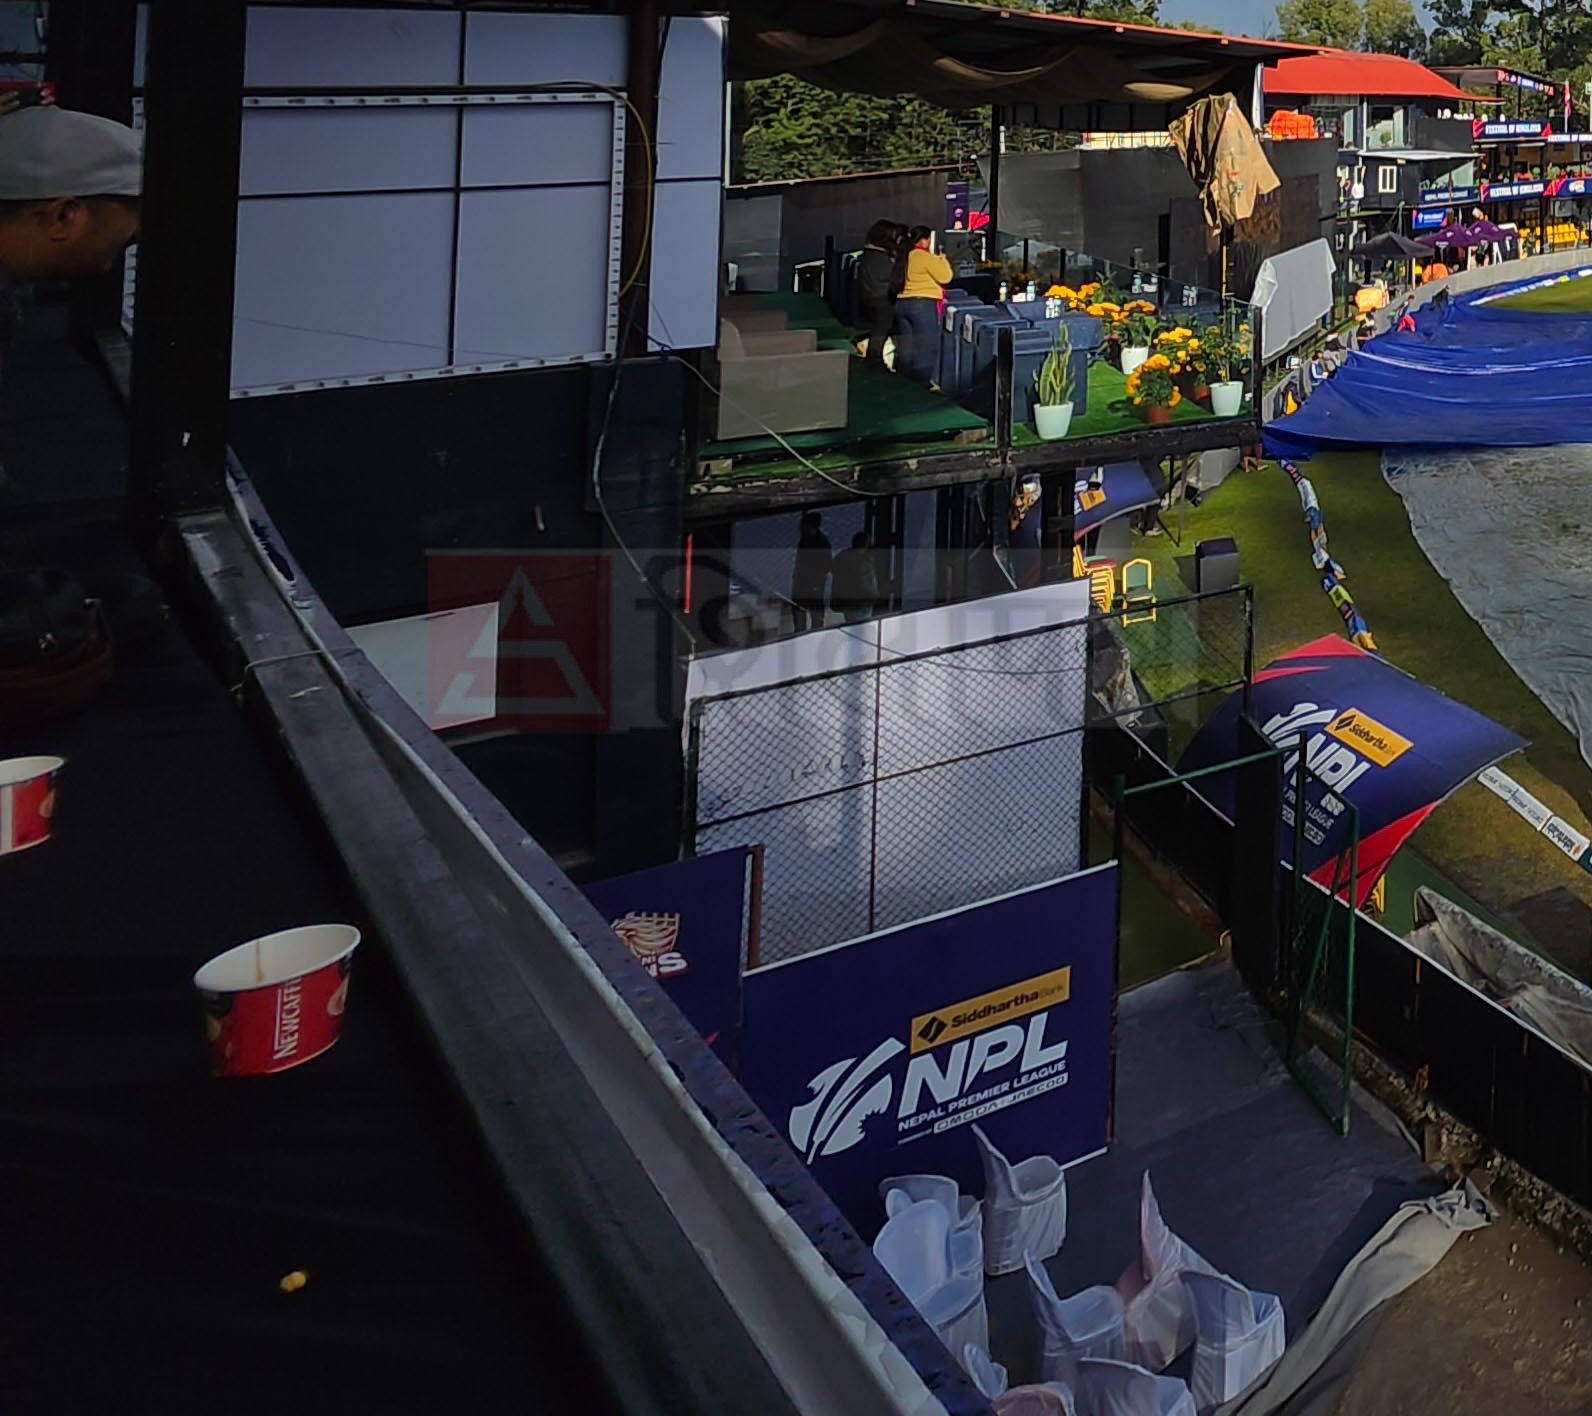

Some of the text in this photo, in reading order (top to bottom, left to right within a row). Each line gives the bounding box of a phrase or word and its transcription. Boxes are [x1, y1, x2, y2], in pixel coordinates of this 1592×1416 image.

[898, 1011, 1069, 1119] NPL
[899, 1060, 1067, 1132] NEPAL PREMIER LEAGUE
